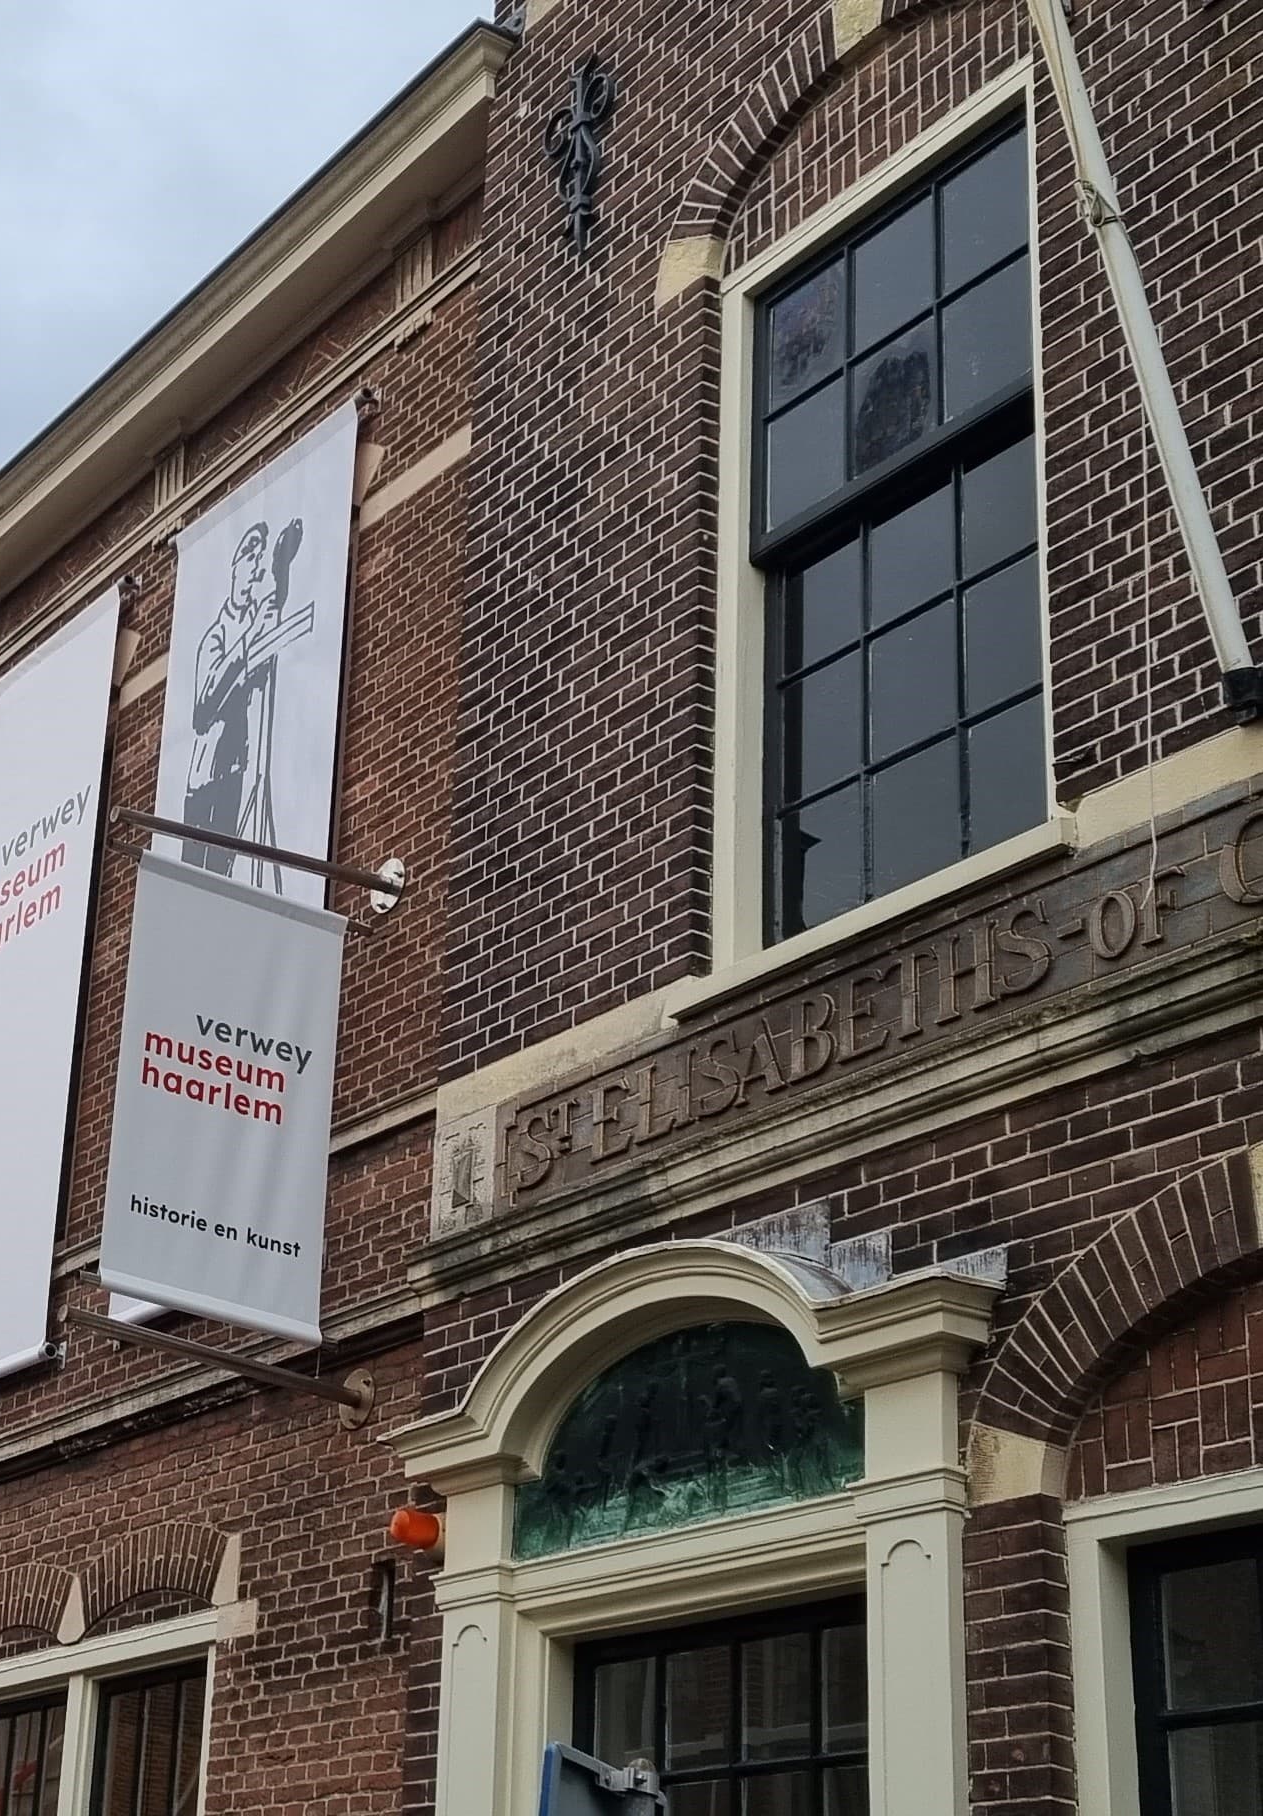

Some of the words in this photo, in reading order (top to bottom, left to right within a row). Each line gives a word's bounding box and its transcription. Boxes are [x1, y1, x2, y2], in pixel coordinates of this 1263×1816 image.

[2, 784, 91, 867] verwey
[144, 1031, 285, 1092] museum
[196, 1014, 312, 1074] verwey
[141, 1058, 283, 1125] haarlem
[130, 1194, 208, 1231] historie
[214, 1223, 238, 1241] en
[247, 1228, 301, 1258] kunst
